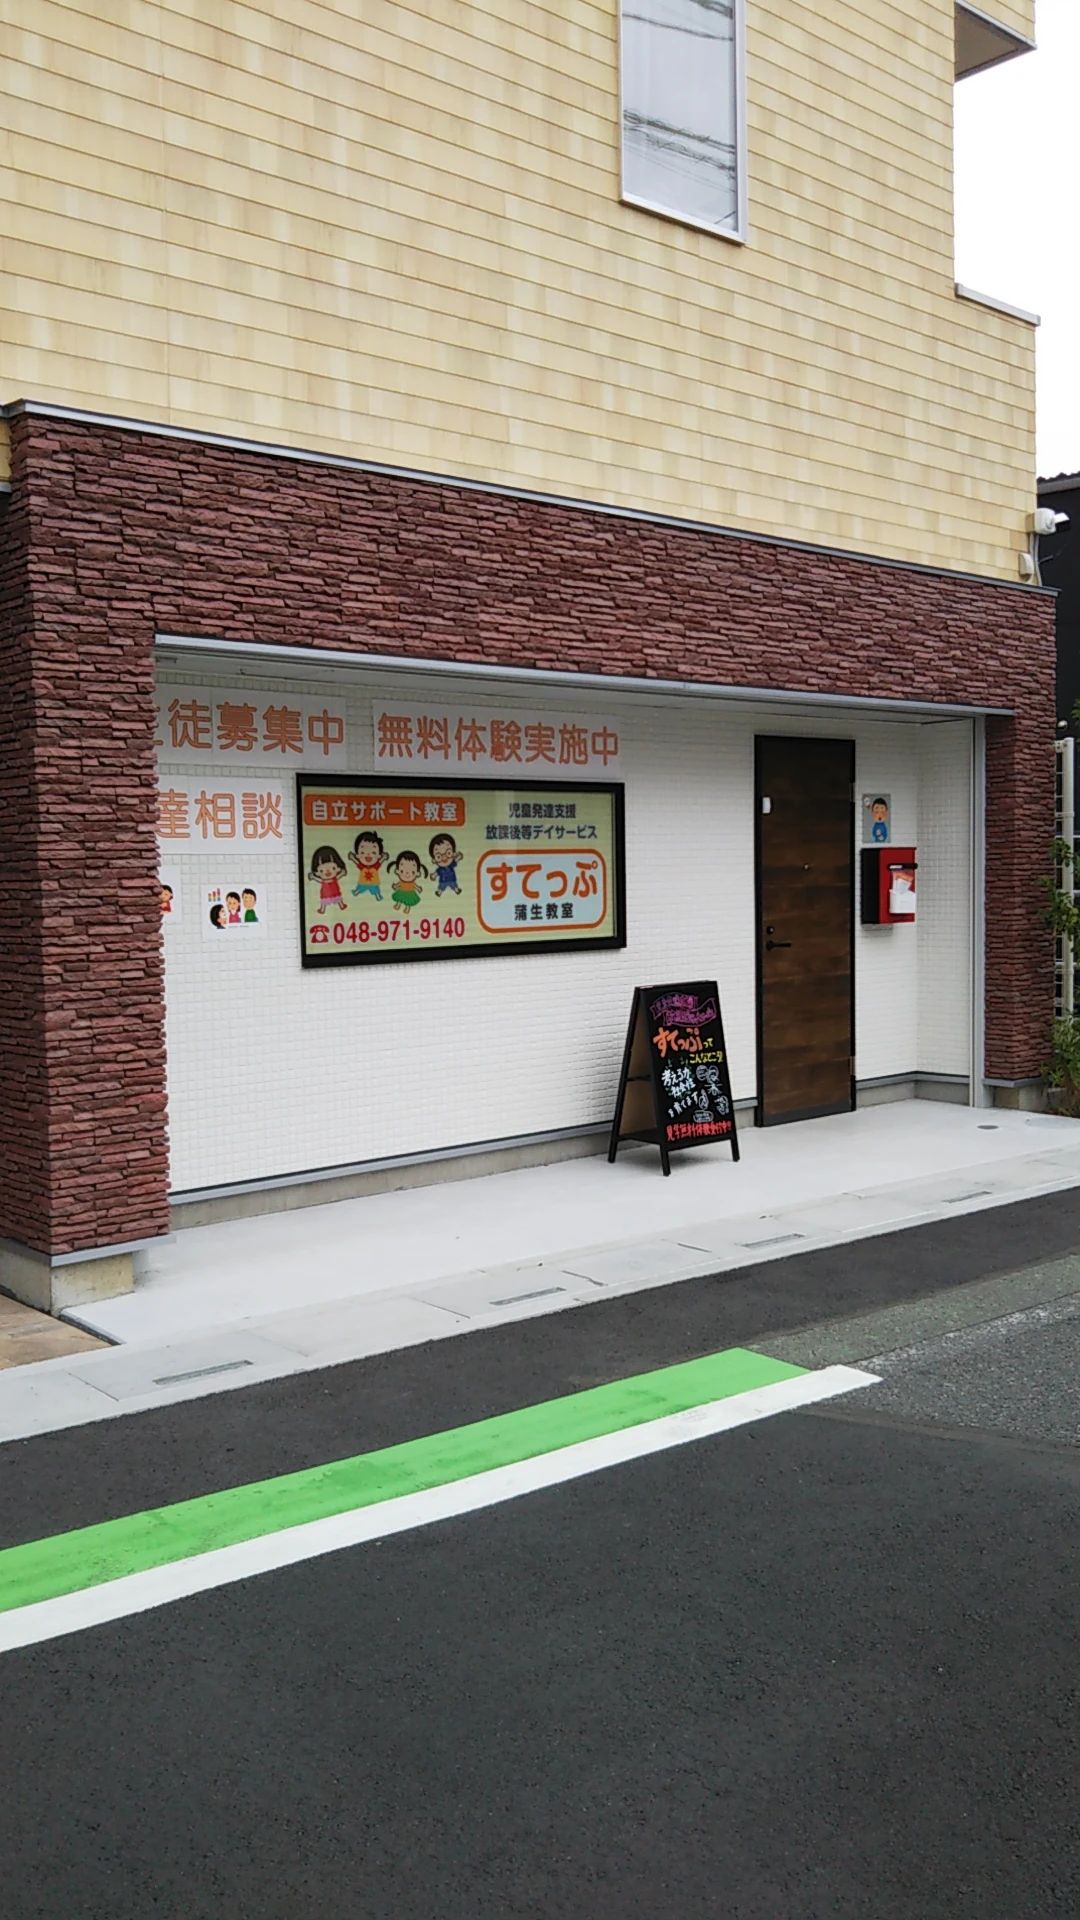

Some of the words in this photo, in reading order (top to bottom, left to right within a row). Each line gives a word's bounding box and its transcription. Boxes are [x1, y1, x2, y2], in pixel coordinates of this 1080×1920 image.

[152, 699, 345, 756] 徒募集中
[377, 712, 619, 766] 無料体験実施中
[312, 800, 459, 822] 自立サポート教室
[509, 803, 577, 819] 児童発達支援
[485, 825, 598, 840] 放課後等デイサービス
[486, 861, 599, 901] すてっぷ
[514, 903, 574, 921] 蒲生教室
[333, 917, 465, 944] 048-971-9140
